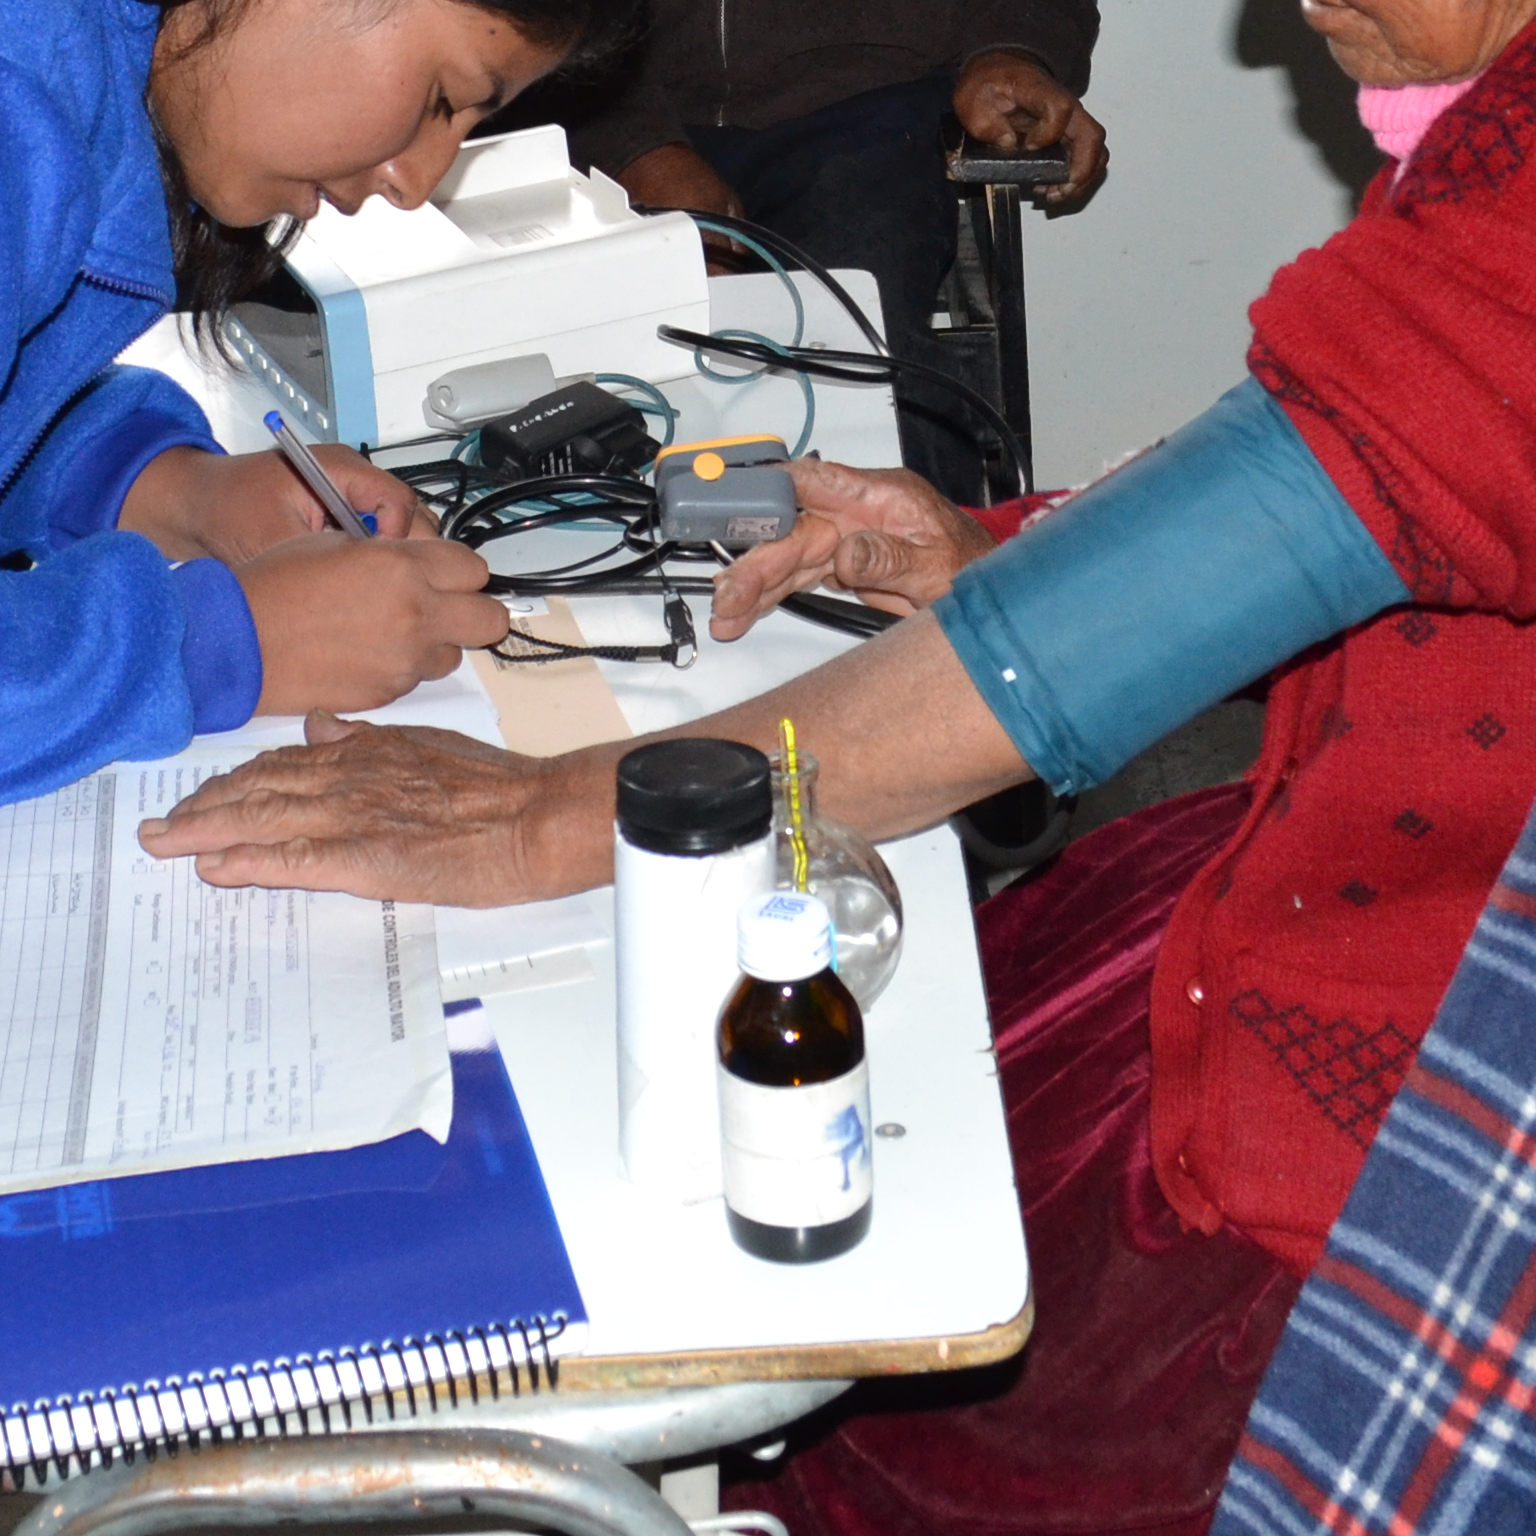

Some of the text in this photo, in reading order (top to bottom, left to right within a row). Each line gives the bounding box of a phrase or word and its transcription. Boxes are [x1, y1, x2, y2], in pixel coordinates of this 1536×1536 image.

[383, 914, 400, 965] CONTROLES
[386, 964, 401, 979] DEL
[387, 981, 402, 1012] ADULTO
[389, 1012, 405, 1043] MAYOR
